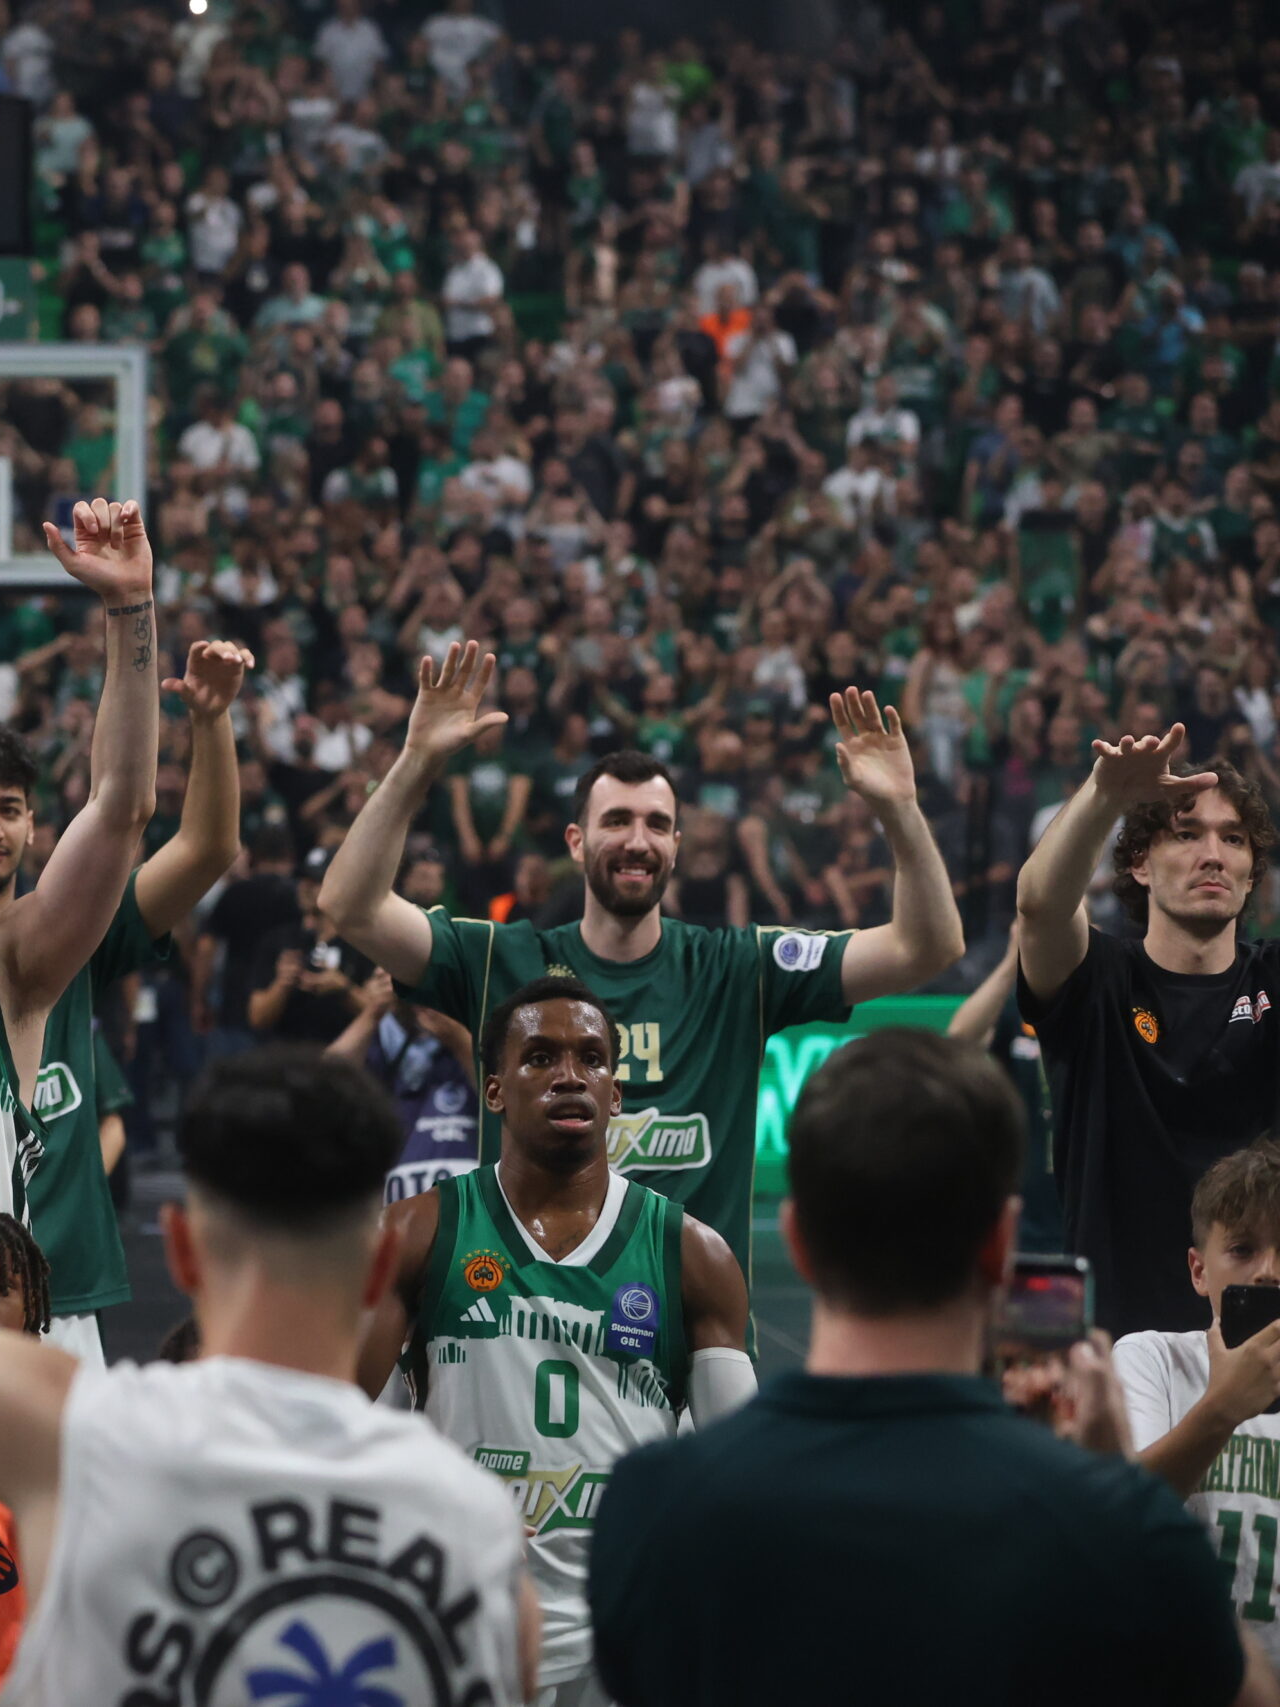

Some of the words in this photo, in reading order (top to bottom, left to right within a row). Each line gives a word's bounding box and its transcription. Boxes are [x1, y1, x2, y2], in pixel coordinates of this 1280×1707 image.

[615, 1022, 664, 1082] 24
[620, 1336, 641, 1348] GBL
[534, 1359, 580, 1438] 0
[1217, 1509, 1278, 1622] 11
